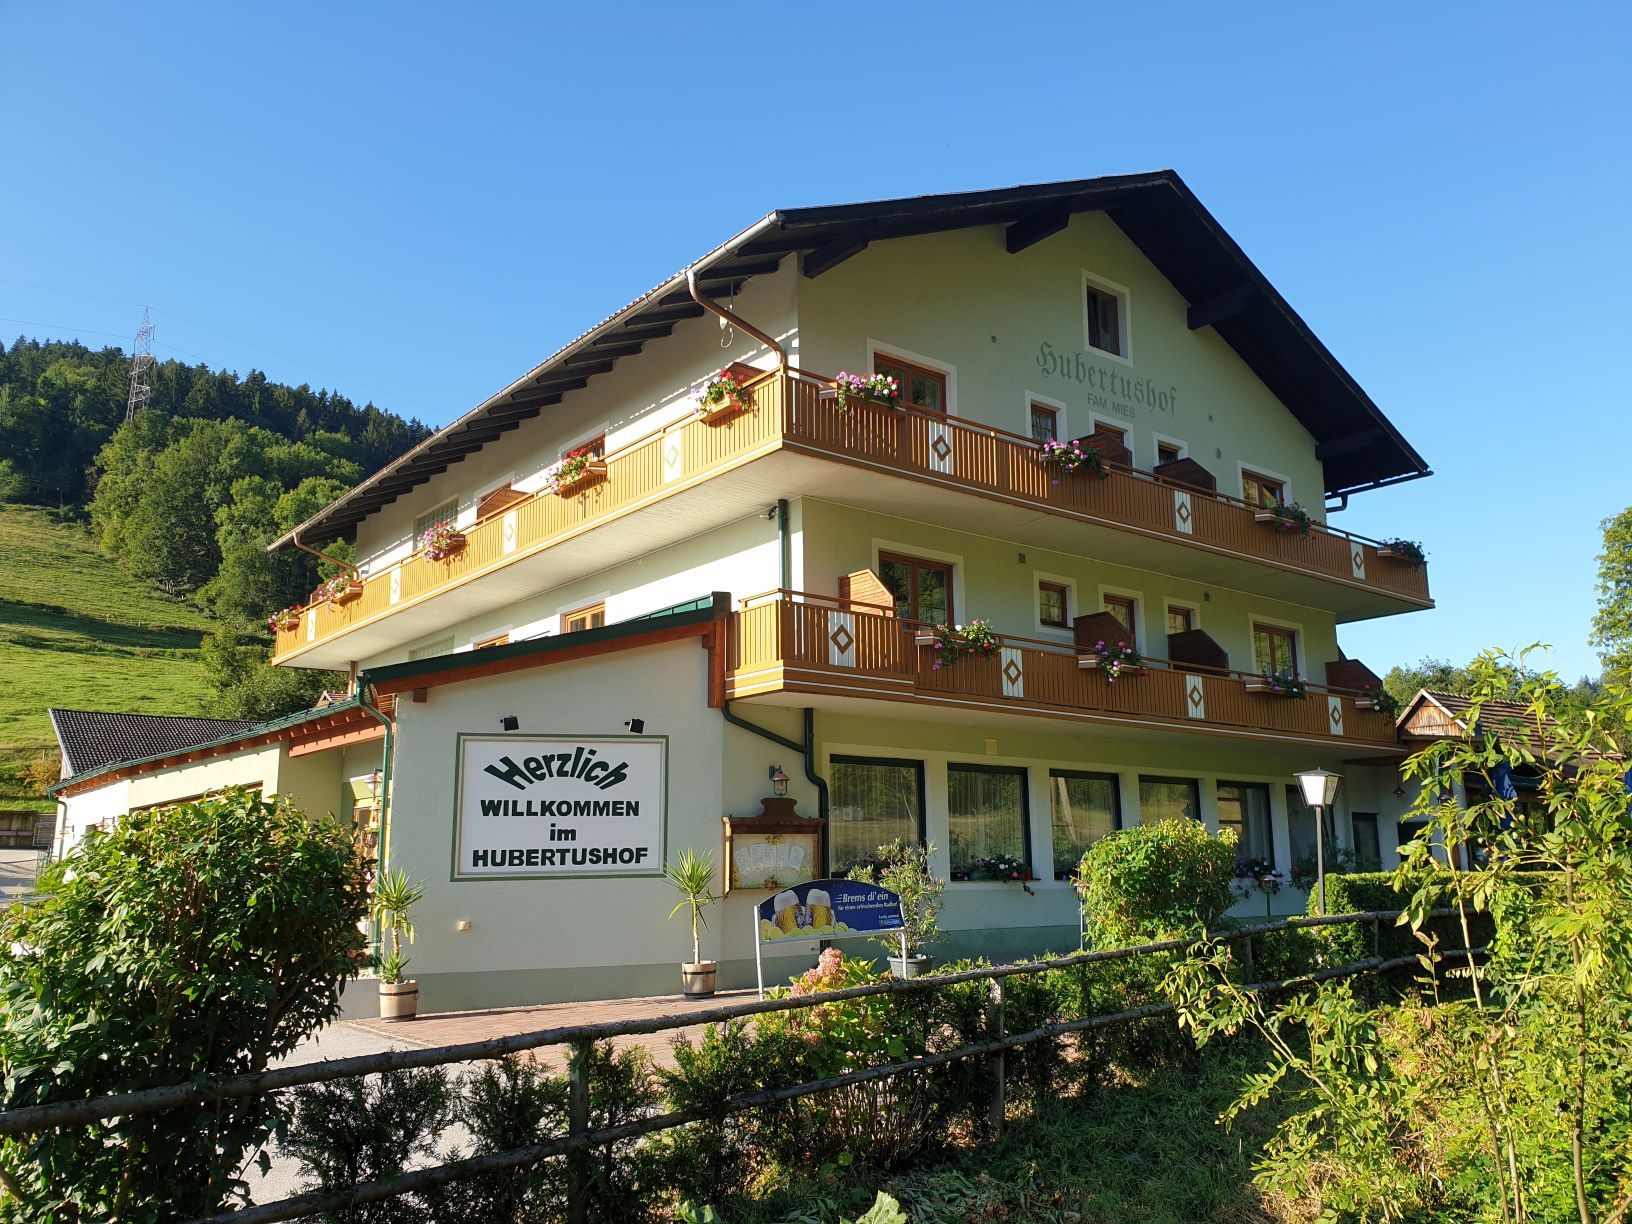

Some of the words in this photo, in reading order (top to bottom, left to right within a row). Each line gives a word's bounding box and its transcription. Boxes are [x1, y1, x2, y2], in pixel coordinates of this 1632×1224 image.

[1036, 341, 1178, 417] Hubertushof
[1087, 392, 1110, 412] FAM.
[1112, 400, 1136, 419] MIES
[483, 746, 629, 791] Herzlich
[480, 799, 640, 817] WILLKOMMEN
[549, 823, 577, 842] im
[472, 847, 648, 868] HUBERTUSHOF
[842, 893, 866, 903] Brems
[877, 891, 888, 901] ein
